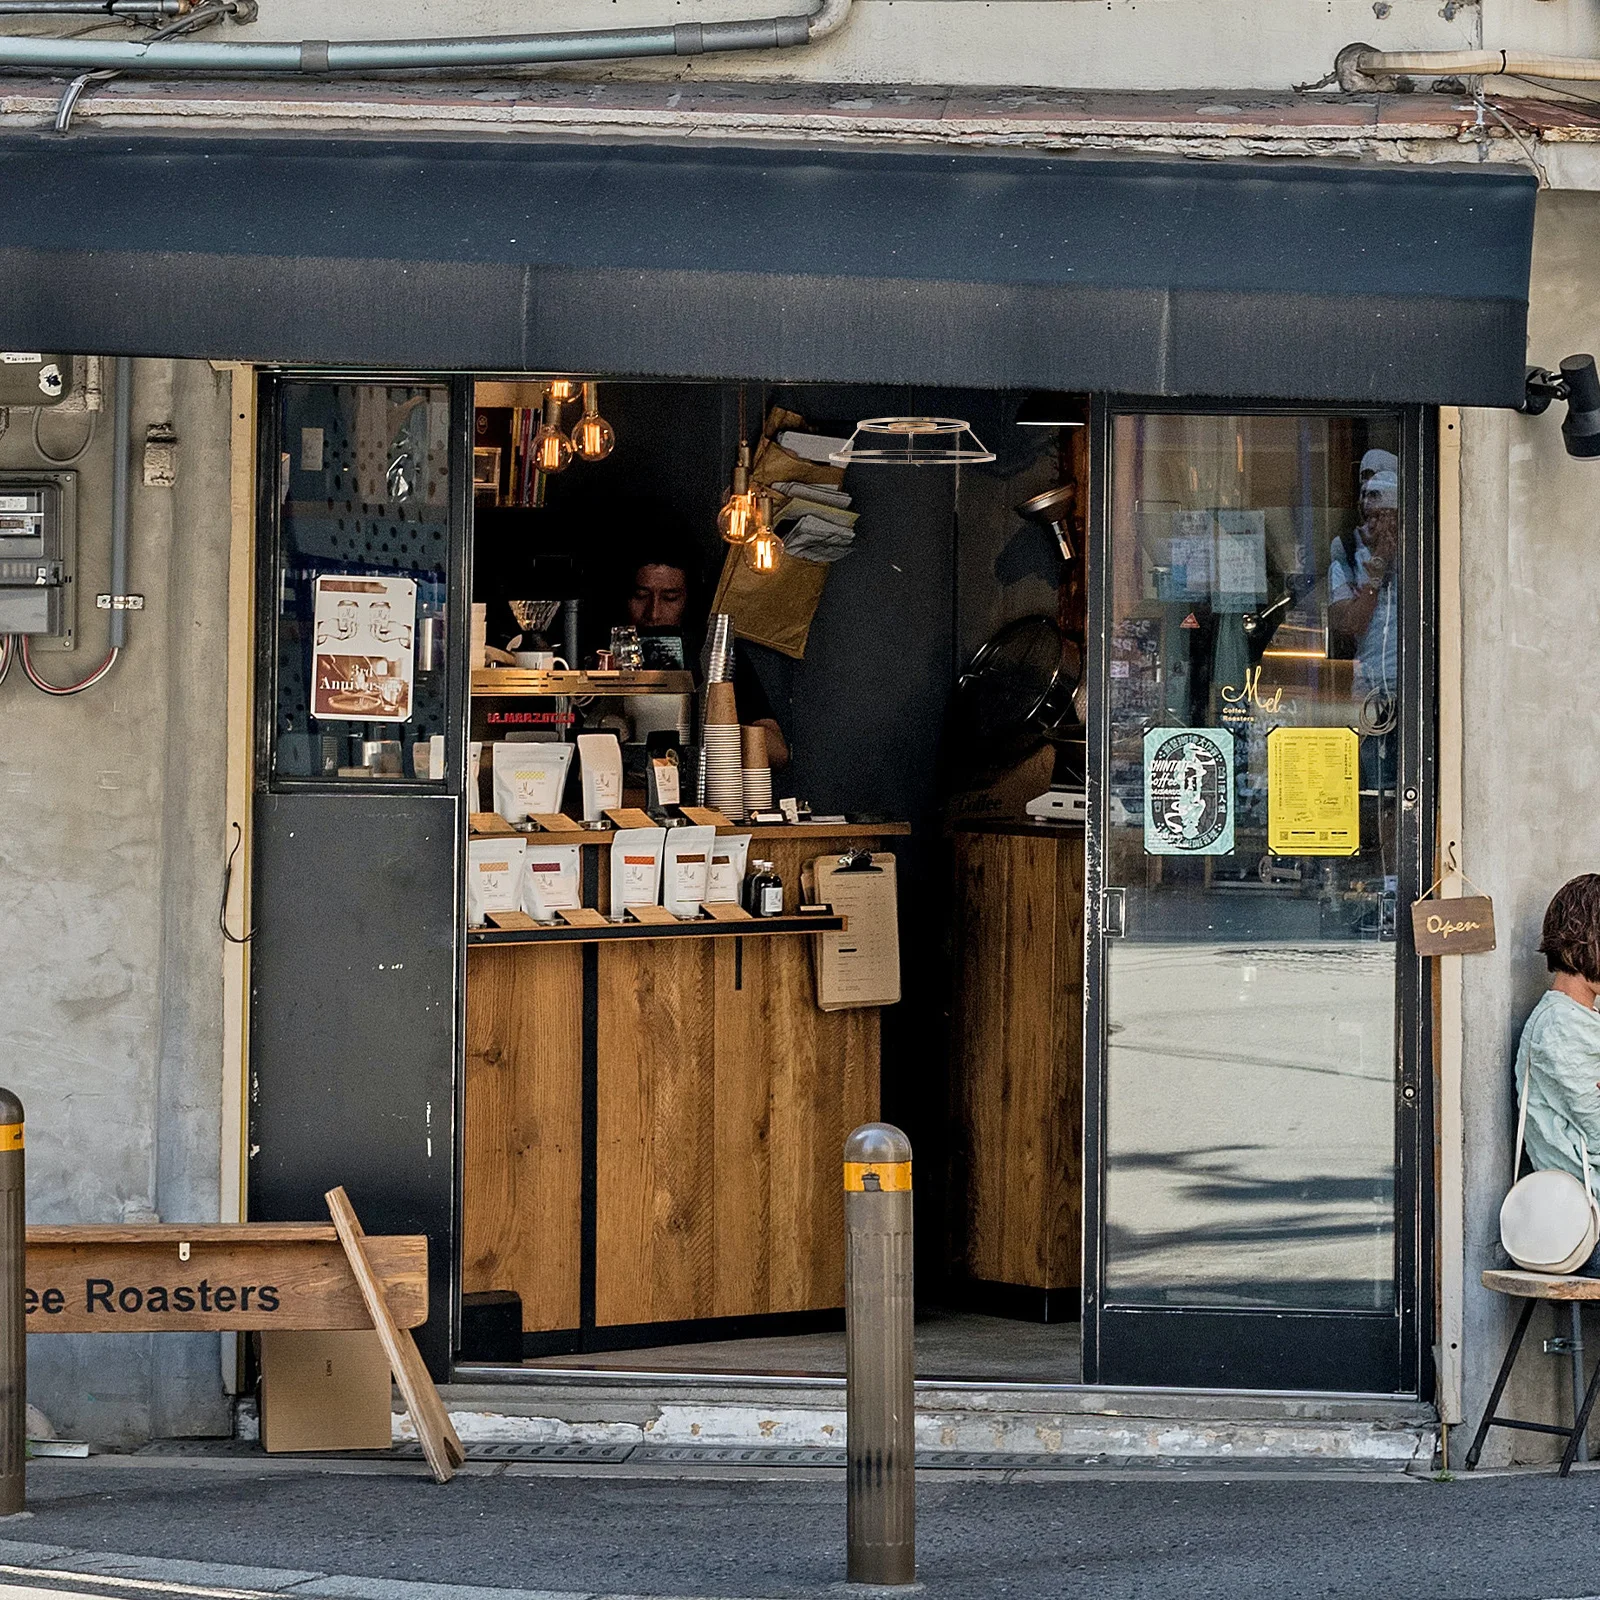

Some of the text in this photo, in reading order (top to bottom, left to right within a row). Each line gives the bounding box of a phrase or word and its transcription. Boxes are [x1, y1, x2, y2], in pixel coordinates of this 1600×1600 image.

[1221, 665, 1282, 713] Mel
[1426, 914, 1481, 939] Open
[25, 1278, 280, 1314] ee Roasters
